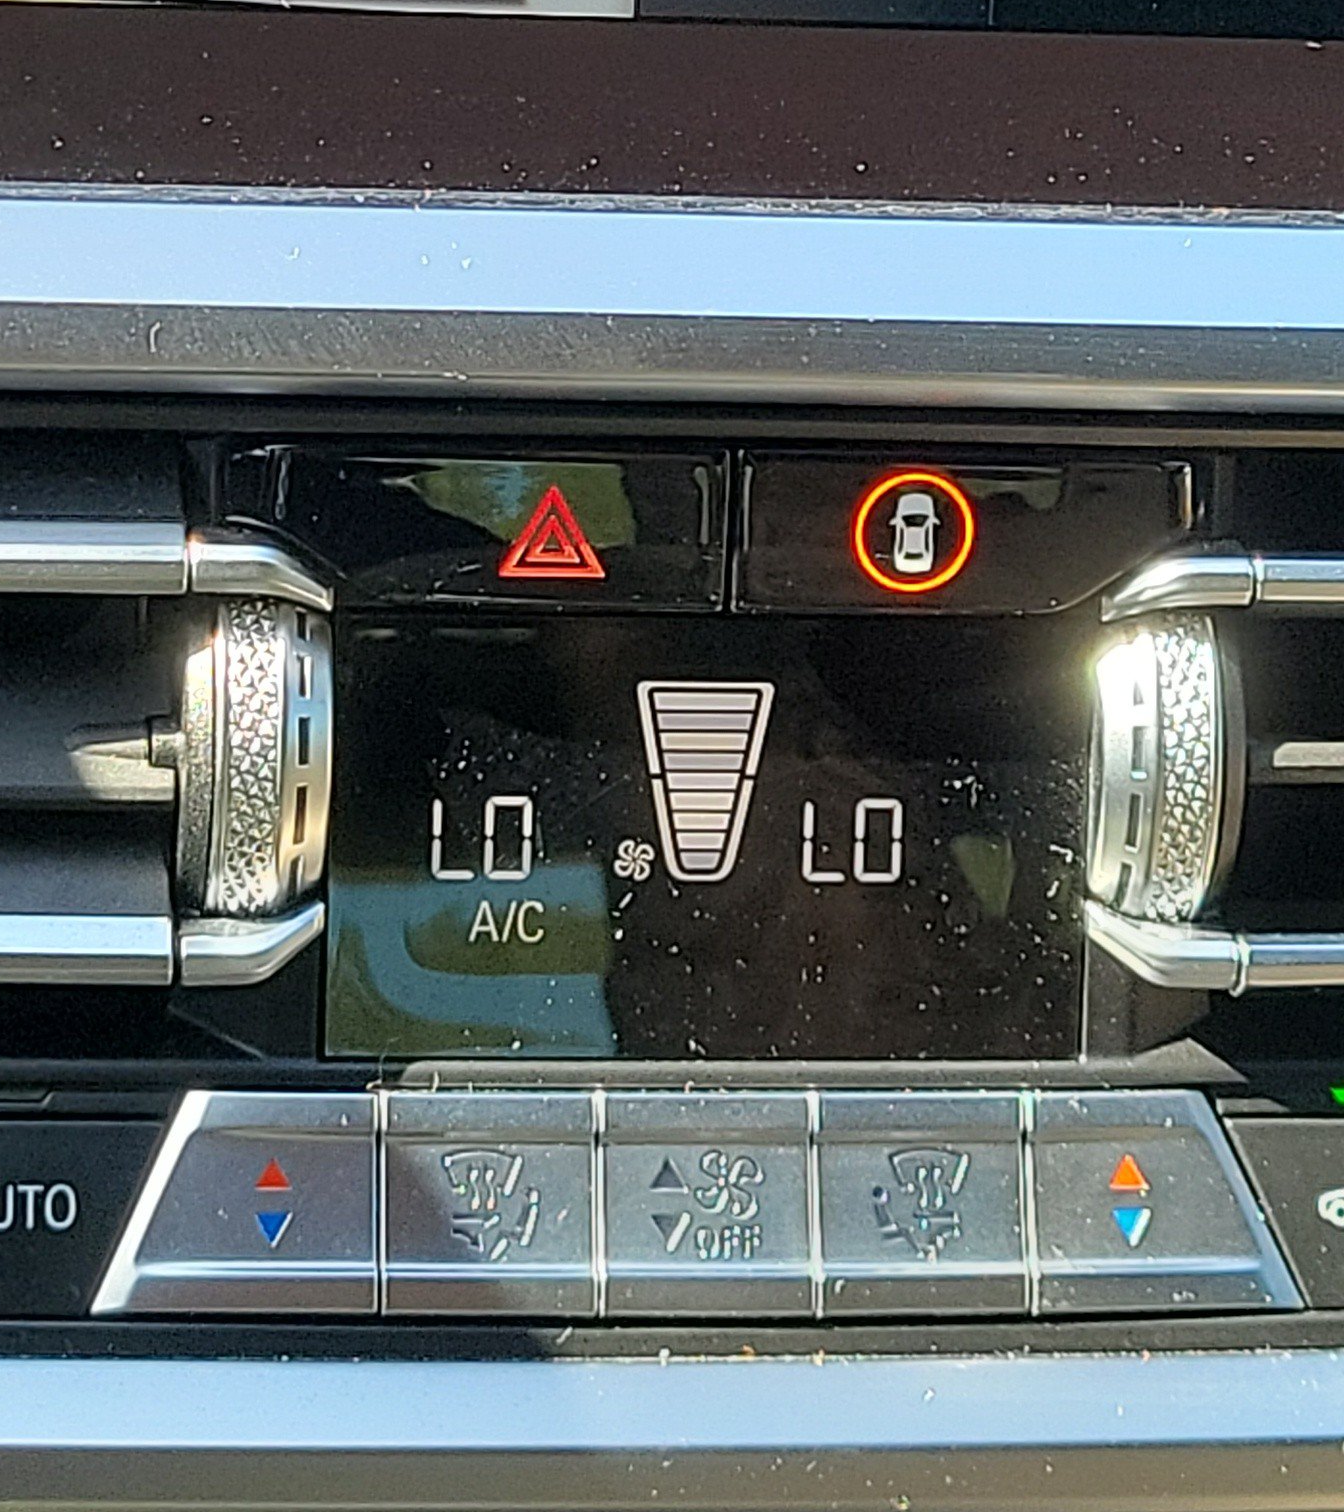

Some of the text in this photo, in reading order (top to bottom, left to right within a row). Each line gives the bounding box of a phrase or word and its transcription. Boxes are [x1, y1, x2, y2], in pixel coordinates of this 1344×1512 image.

[431, 796, 532, 880] LO
[802, 798, 902, 883] LO
[468, 901, 545, 943] A/C
